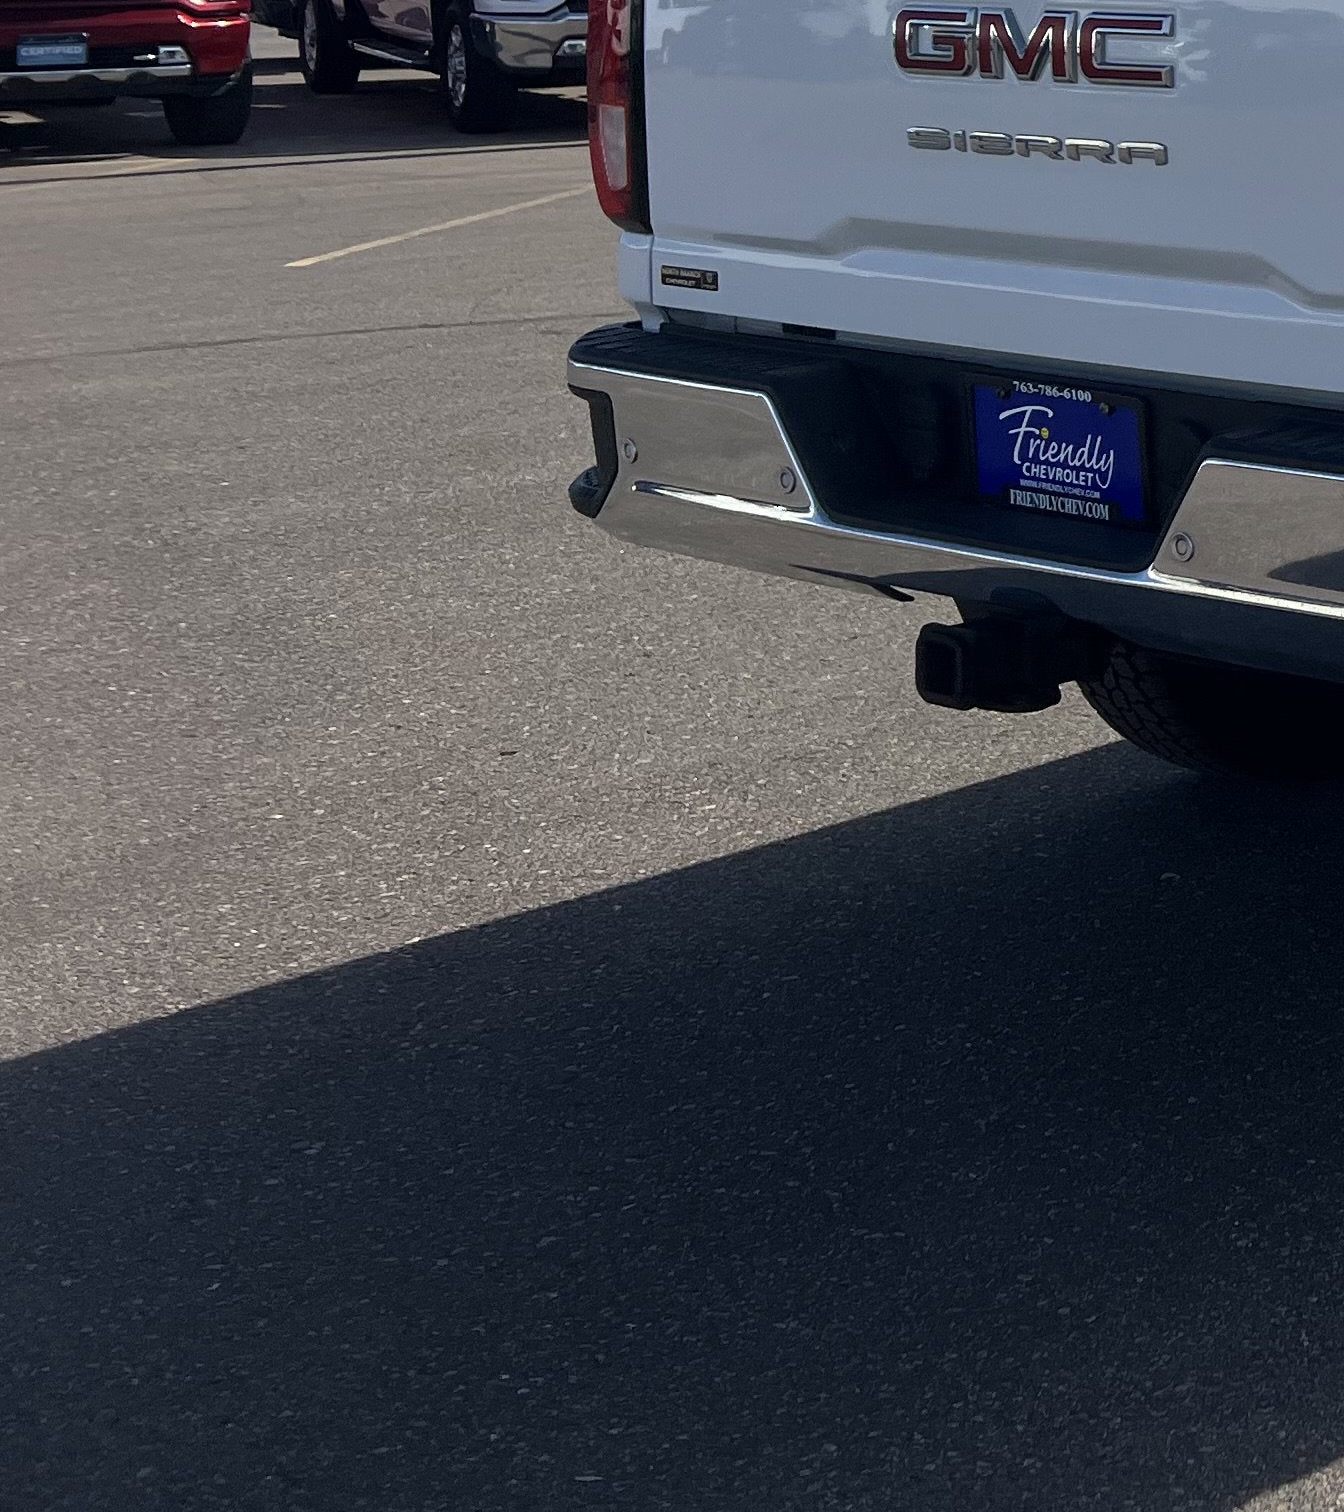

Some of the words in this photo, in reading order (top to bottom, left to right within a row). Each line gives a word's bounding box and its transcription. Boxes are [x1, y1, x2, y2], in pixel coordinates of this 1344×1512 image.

[20, 45, 83, 56] CERTIFIED
[893, 5, 1175, 88] GMC
[906, 126, 1169, 166] SIERRA
[1012, 380, 1092, 403] 763-786-6100
[999, 405, 1115, 488] Friendly
[1022, 462, 1094, 486] CHEVROLET
[1010, 488, 1110, 521] FRIENDLYCHEV.COM
